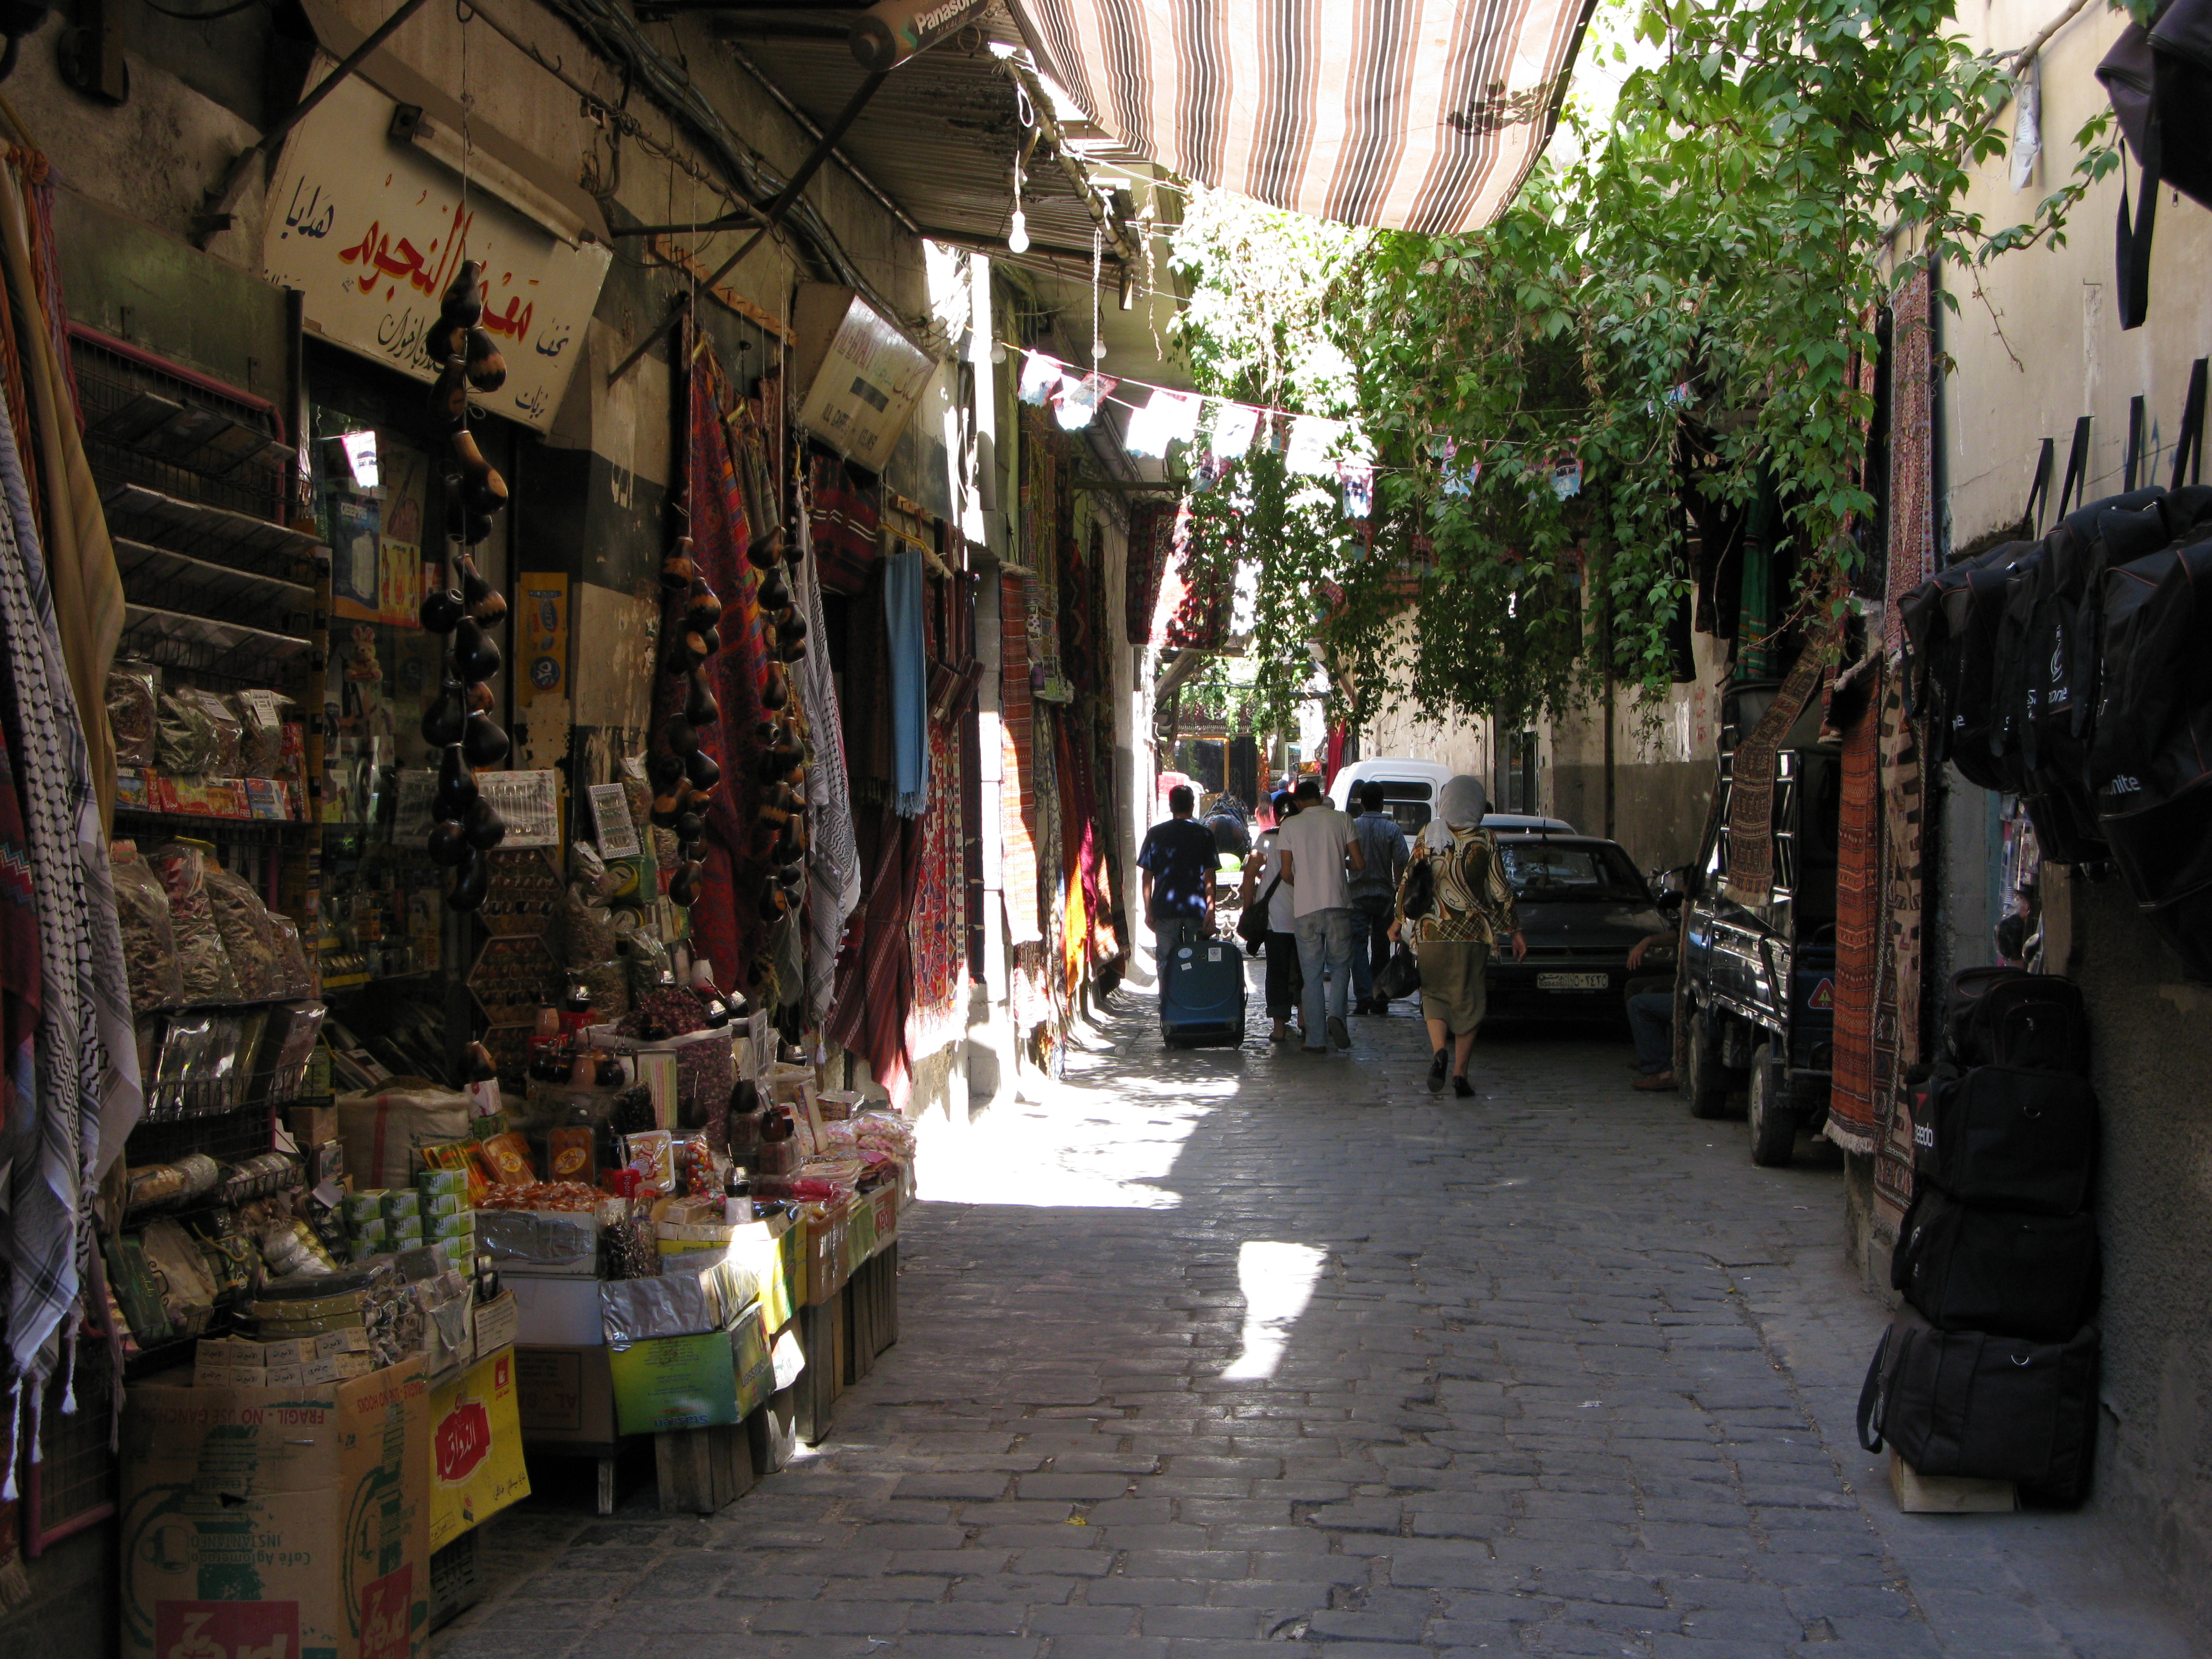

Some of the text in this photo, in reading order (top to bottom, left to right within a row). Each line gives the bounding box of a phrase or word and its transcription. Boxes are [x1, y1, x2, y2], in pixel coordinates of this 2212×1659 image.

[914, 0, 978, 35] Panaso
[281, 175, 334, 239] هدايا
[543, 602, 554, 630] ULTRA
[239, 808, 251, 818] FREE
[1913, 1122, 1933, 1147] eedo
[623, 1175, 631, 1196] Pipore
[740, 1359, 765, 1388] Stassen
[357, 1381, 423, 1413] FRAGILE USE NO HOOKS
[211, 1408, 237, 1425] USE
[241, 1409, 264, 1425] NO
[278, 1409, 325, 1425] FRAGIL
[655, 1415, 708, 1428] Stassen
[445, 1417, 476, 1474] الذواق
[190, 1533, 280, 1548] INSTANTANEO
[190, 1550, 311, 1567] Café Aglomerado
